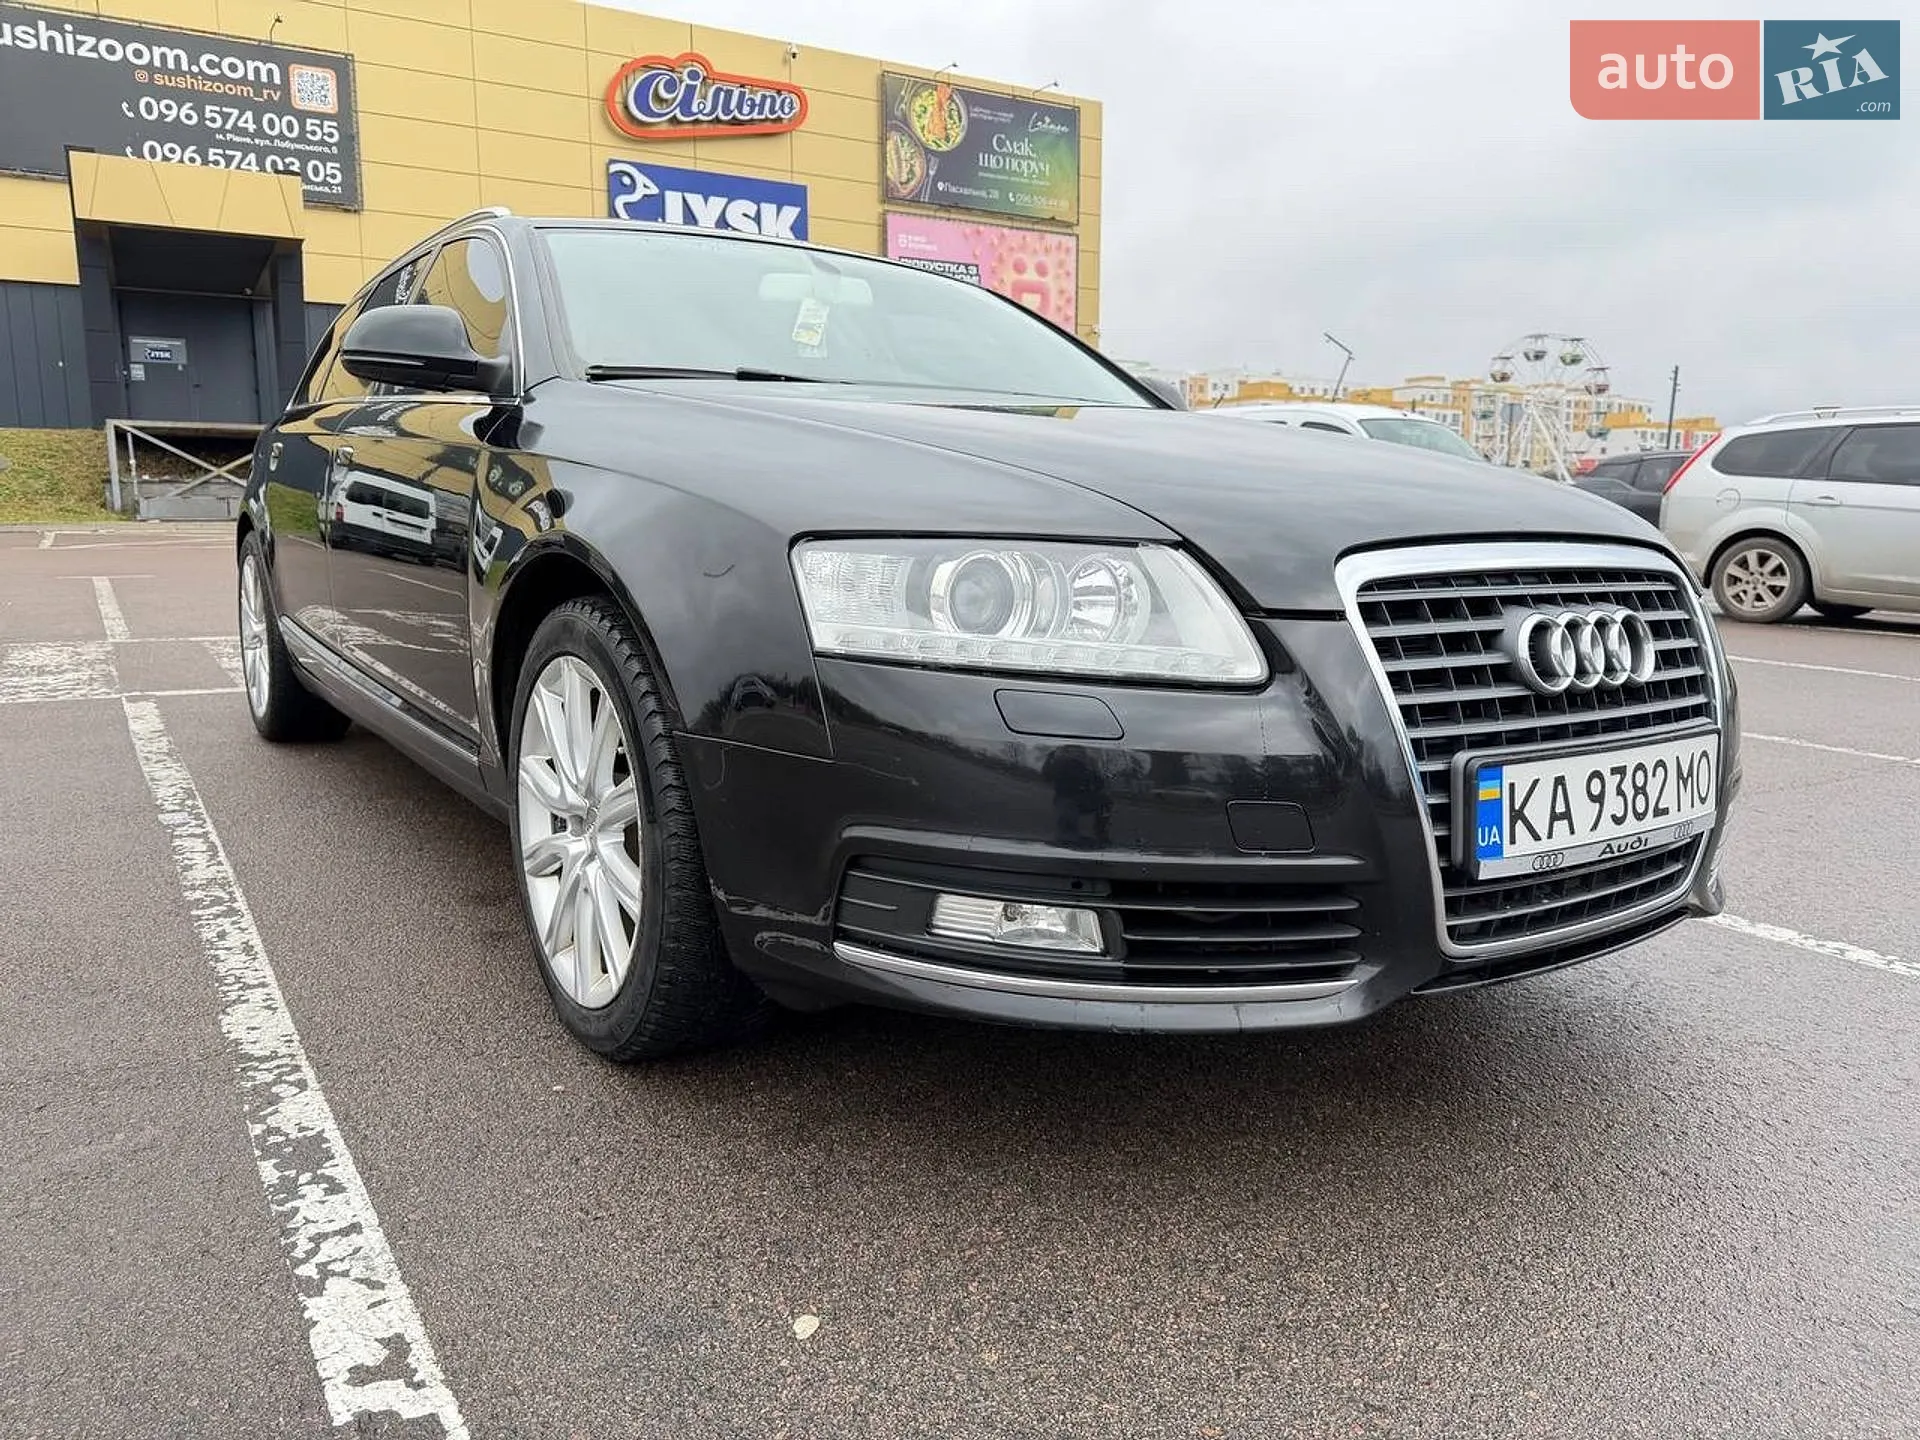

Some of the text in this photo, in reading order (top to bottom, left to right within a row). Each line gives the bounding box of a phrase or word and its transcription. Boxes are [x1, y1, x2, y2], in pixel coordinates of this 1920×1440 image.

[153, 71, 281, 102] sushizoom_rv
[627, 67, 799, 123] Сільпо
[139, 96, 340, 143] 096 574 00 55
[142, 140, 201, 167] 096
[208, 147, 260, 173] 574
[306, 159, 342, 184] 05
[1508, 749, 1712, 846] KA 9382 MO
[1478, 827, 1501, 847] UA
[1598, 837, 1649, 858] Audi
